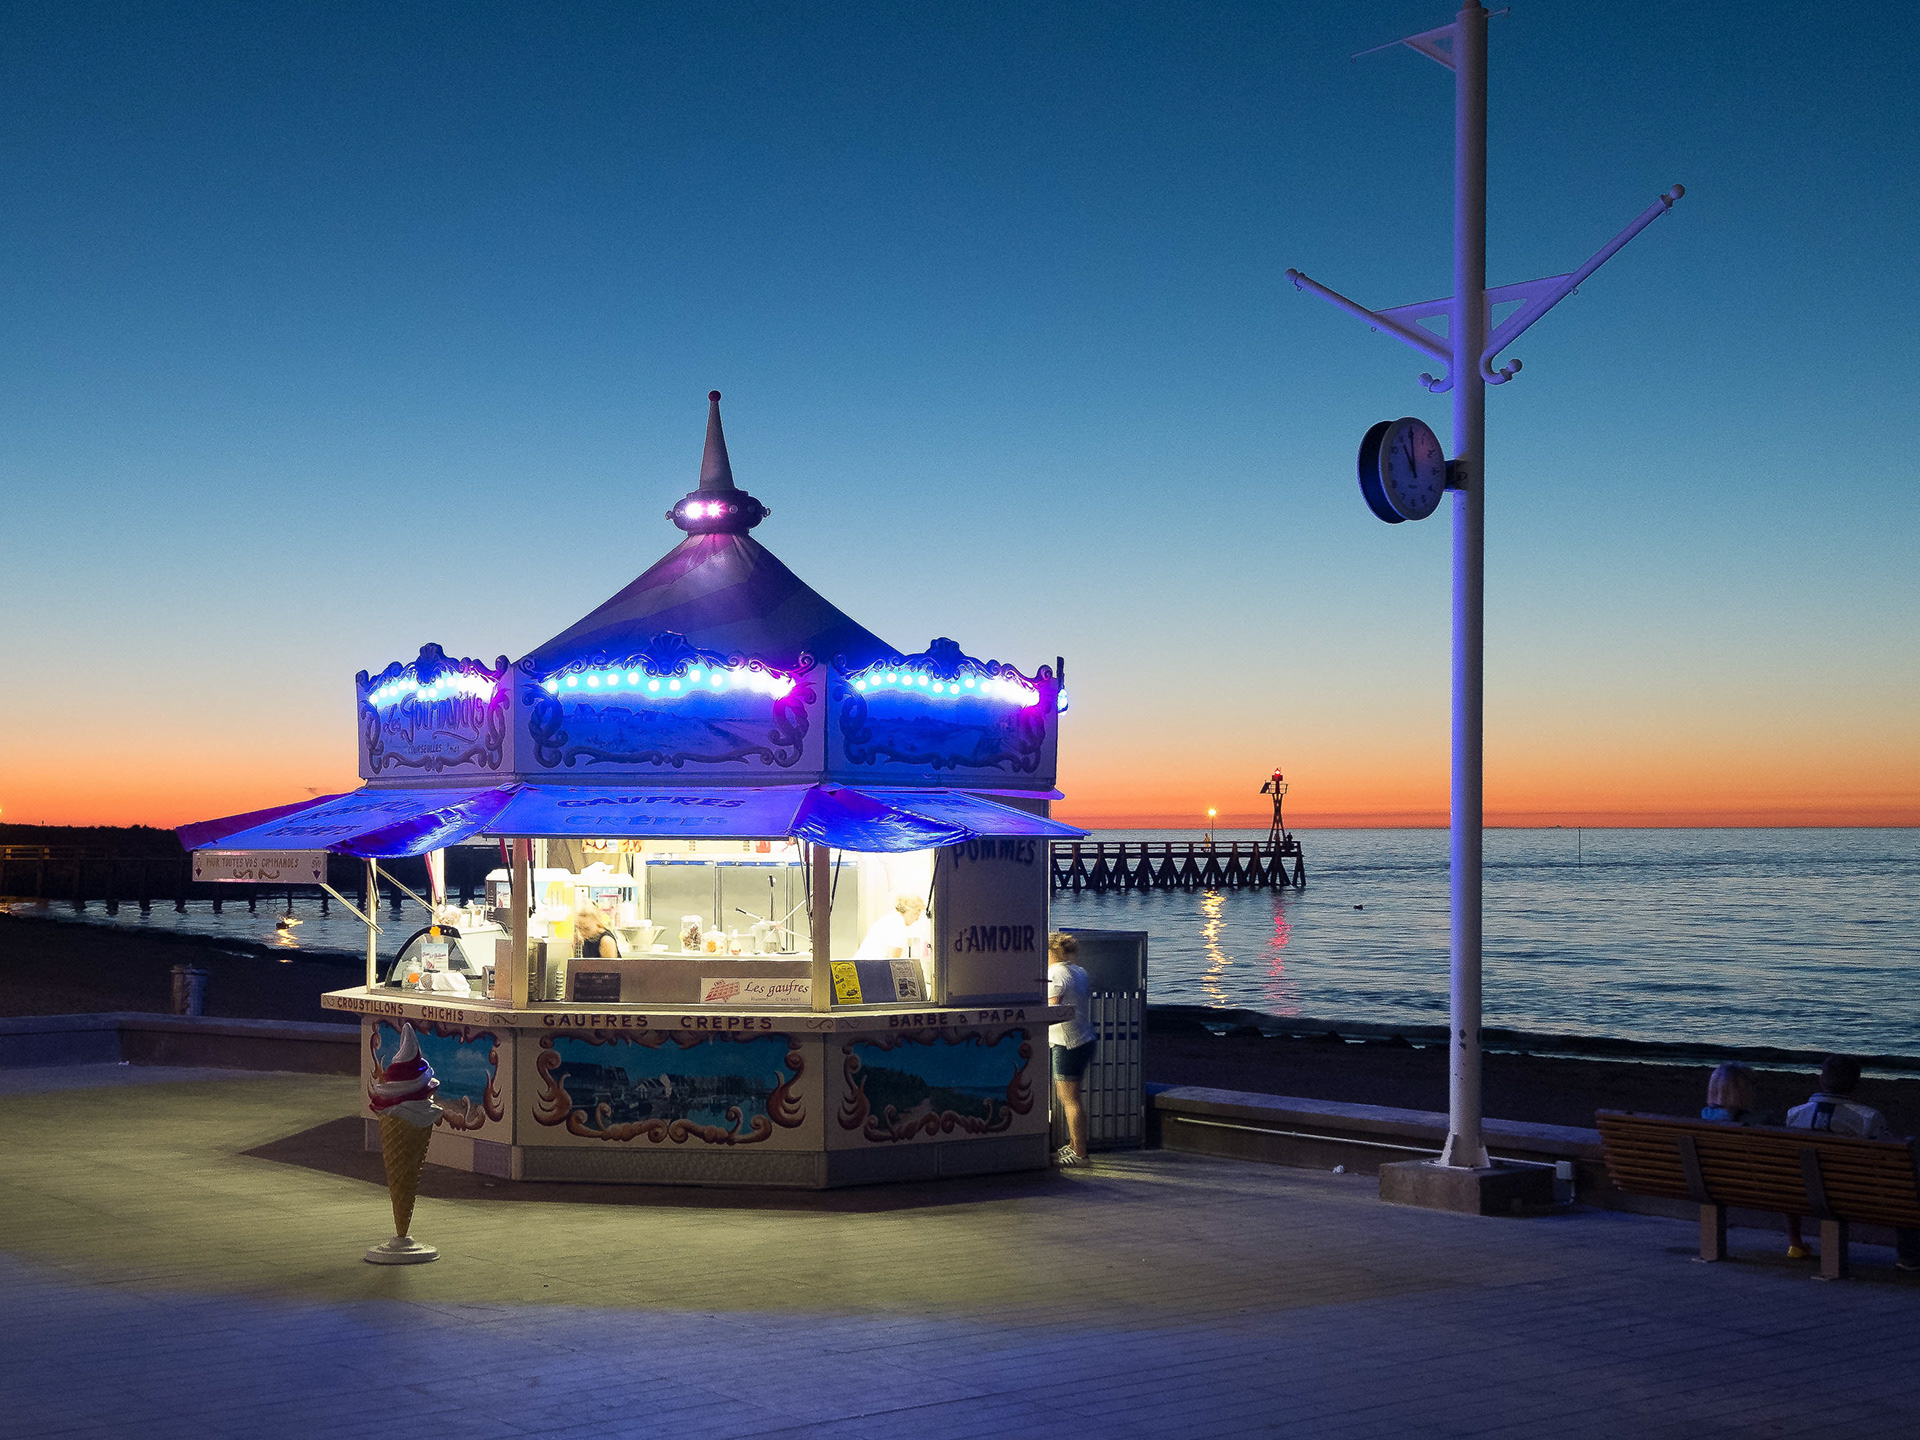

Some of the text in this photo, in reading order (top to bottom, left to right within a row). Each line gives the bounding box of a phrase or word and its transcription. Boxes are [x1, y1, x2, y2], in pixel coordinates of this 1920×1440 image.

[557, 796, 746, 808] GAUFRES
[952, 836, 1036, 869] POMMES
[206, 857, 220, 868] POUR
[222, 857, 244, 868] TOUTES
[245, 857, 258, 868] VOS
[261, 857, 300, 869] COMMANDES
[954, 925, 1035, 954] d'AMOUR
[744, 980, 809, 997] Les gaufres
[338, 997, 464, 1021] CROUSTILLONS CHICHIS
[543, 1014, 773, 1030] GAUFRES CREPES
[889, 1012, 948, 1027] BARBE
[979, 1009, 1027, 1023] PAPA
